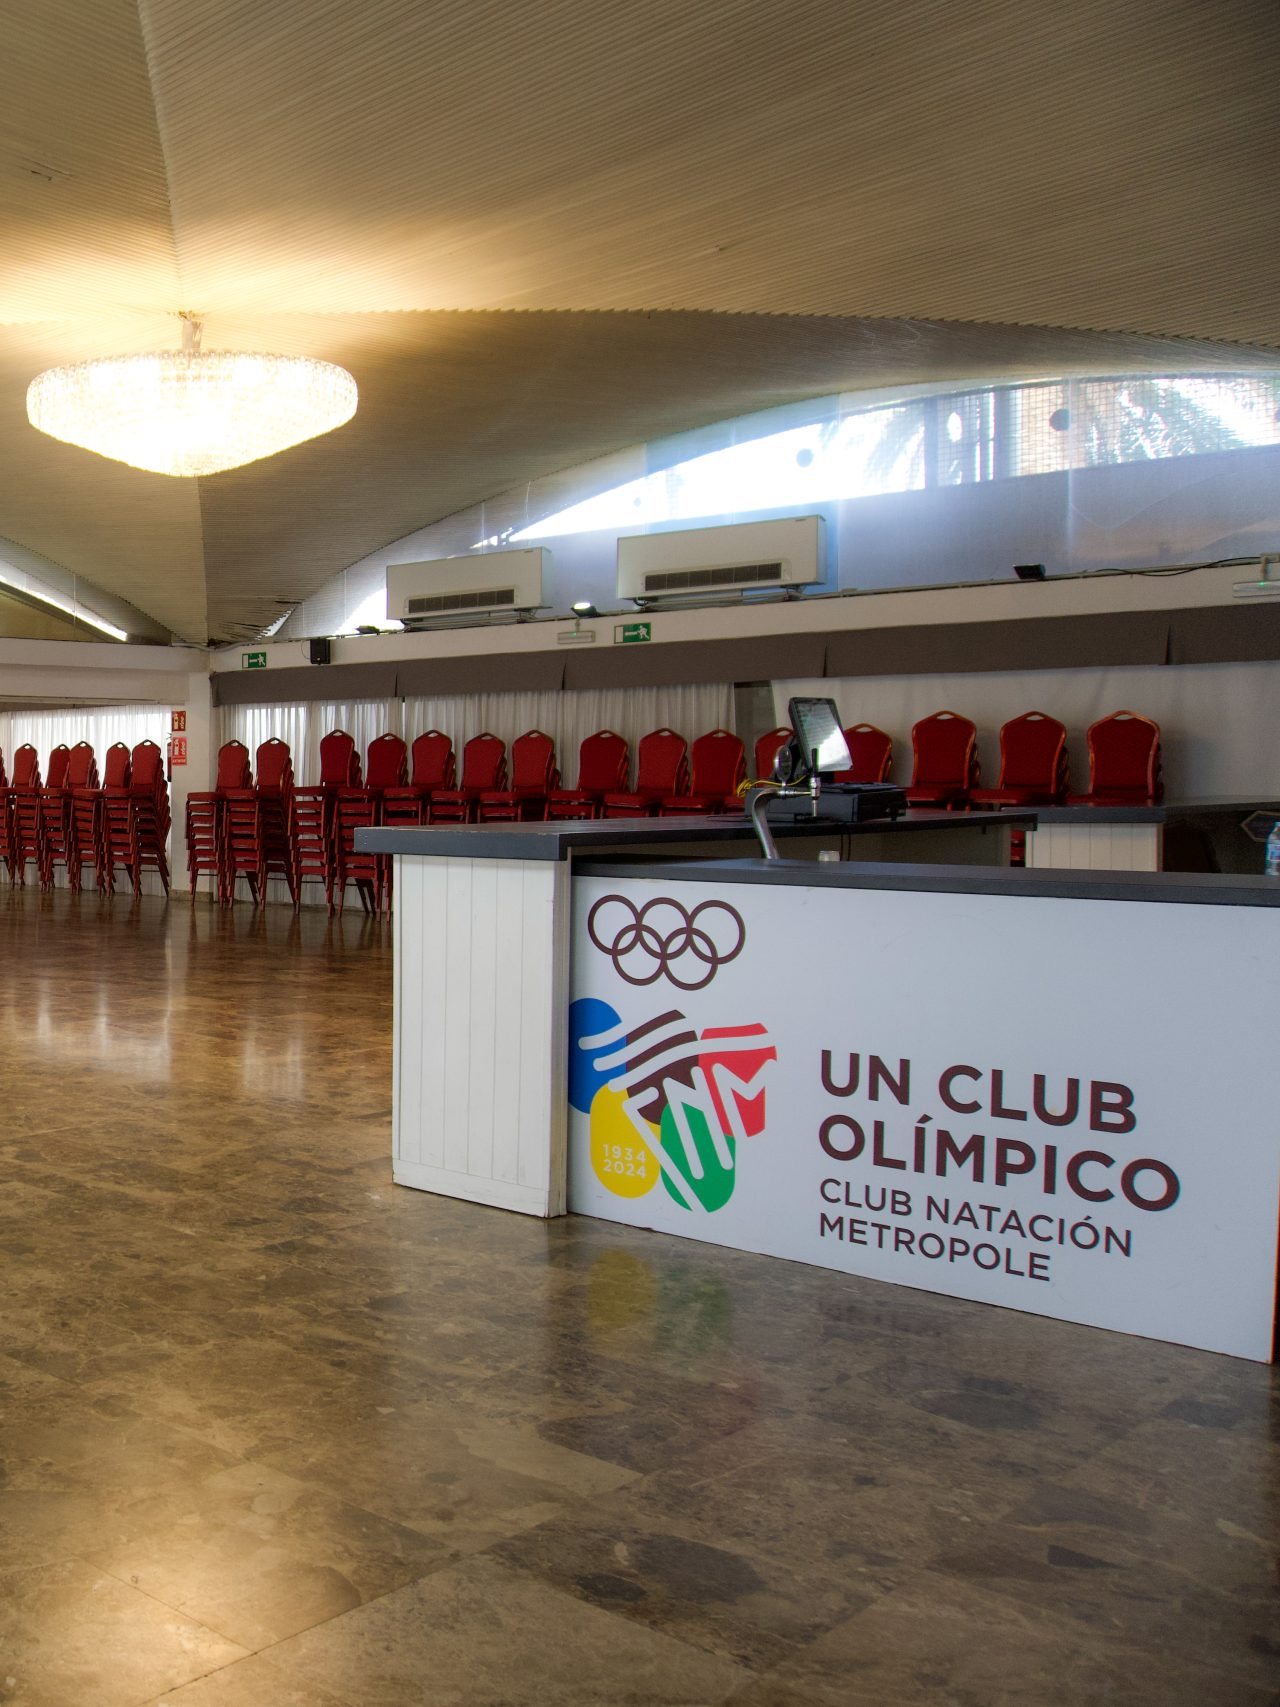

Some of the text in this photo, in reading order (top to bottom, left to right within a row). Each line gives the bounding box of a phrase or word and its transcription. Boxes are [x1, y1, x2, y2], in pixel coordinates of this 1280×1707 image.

[821, 1049, 1137, 1135] UN CLUB
[603, 1144, 646, 1163] 1934
[603, 1159, 646, 1178] 2024
[818, 1113, 1181, 1212] OLÍMPICO
[819, 1178, 1132, 1258] CLUB NATACIÓN
[820, 1212, 1051, 1282] METROPOLE
